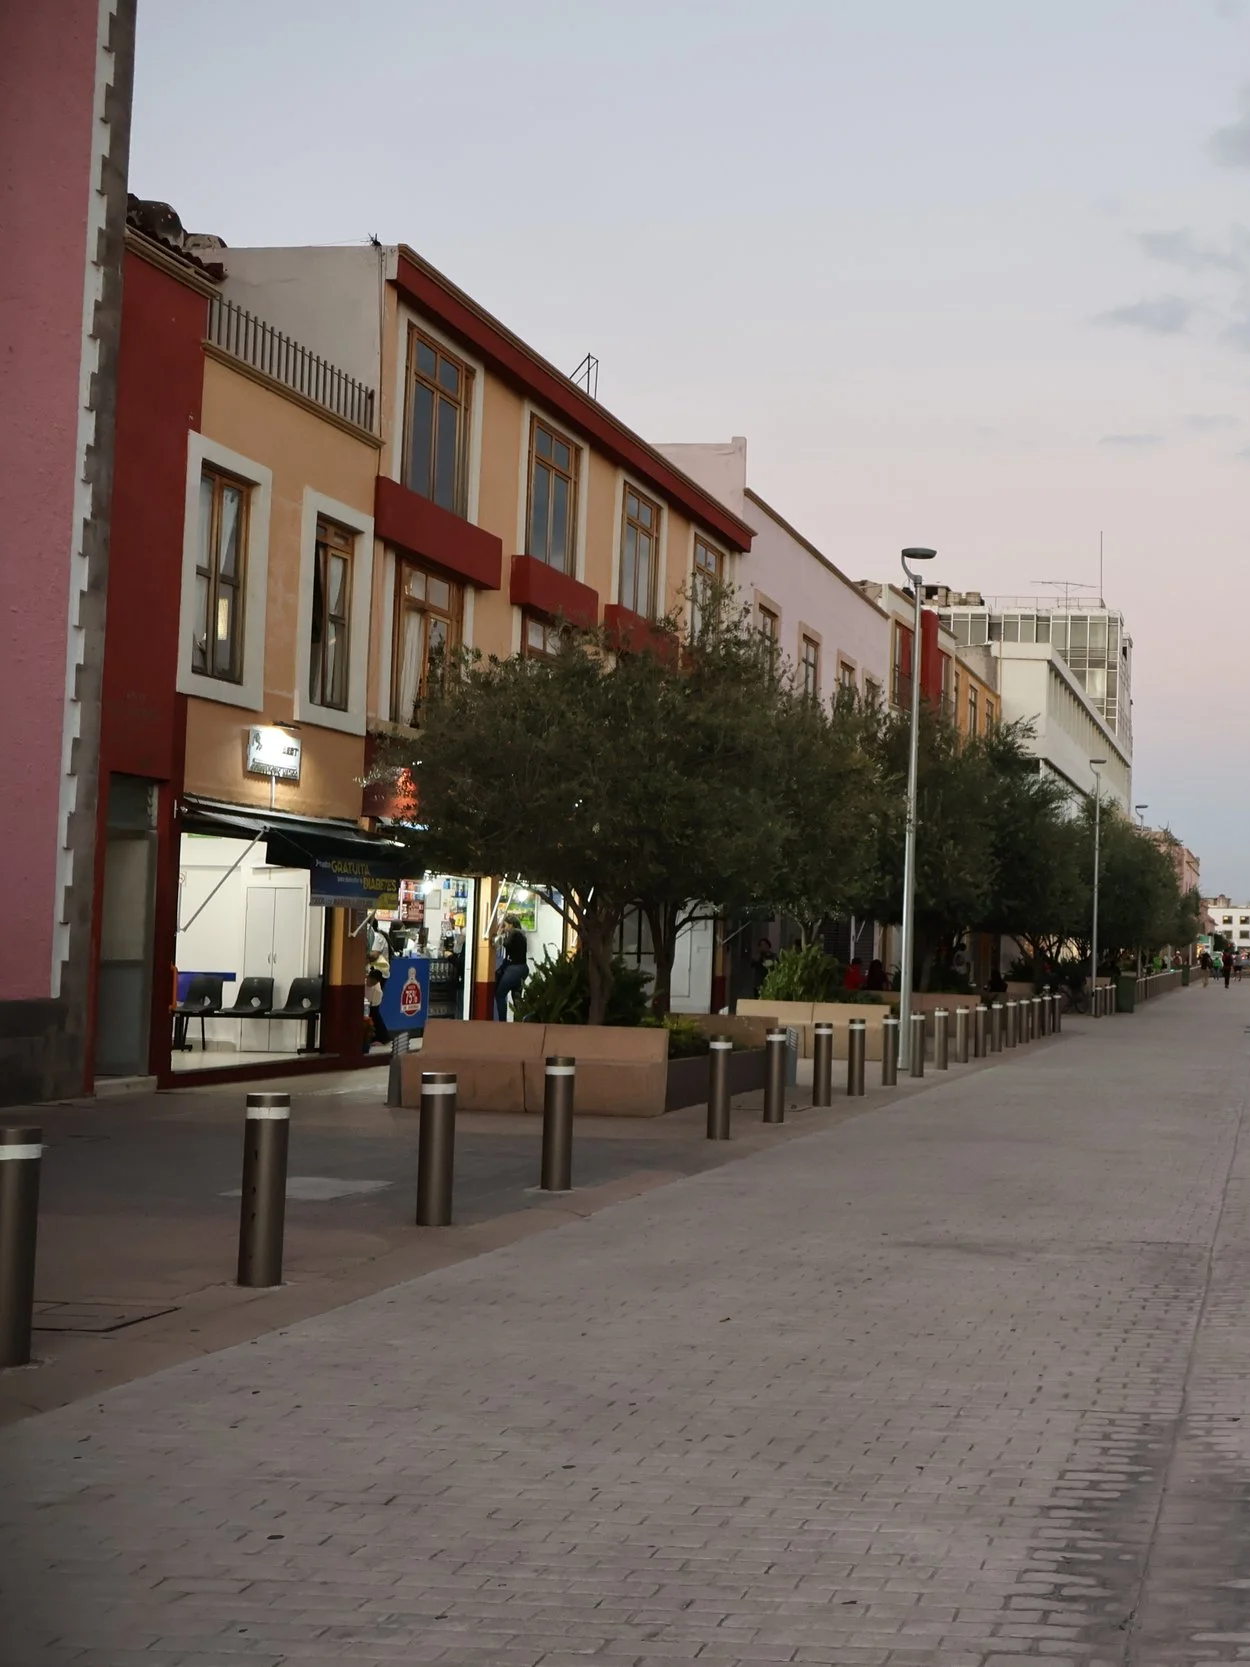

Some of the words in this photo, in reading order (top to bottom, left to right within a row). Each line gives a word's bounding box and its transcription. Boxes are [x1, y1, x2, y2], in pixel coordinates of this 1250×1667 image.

[331, 860, 371, 876] GRATUITA
[363, 877, 397, 892] DIABETES
[405, 989, 418, 1004] 75%
